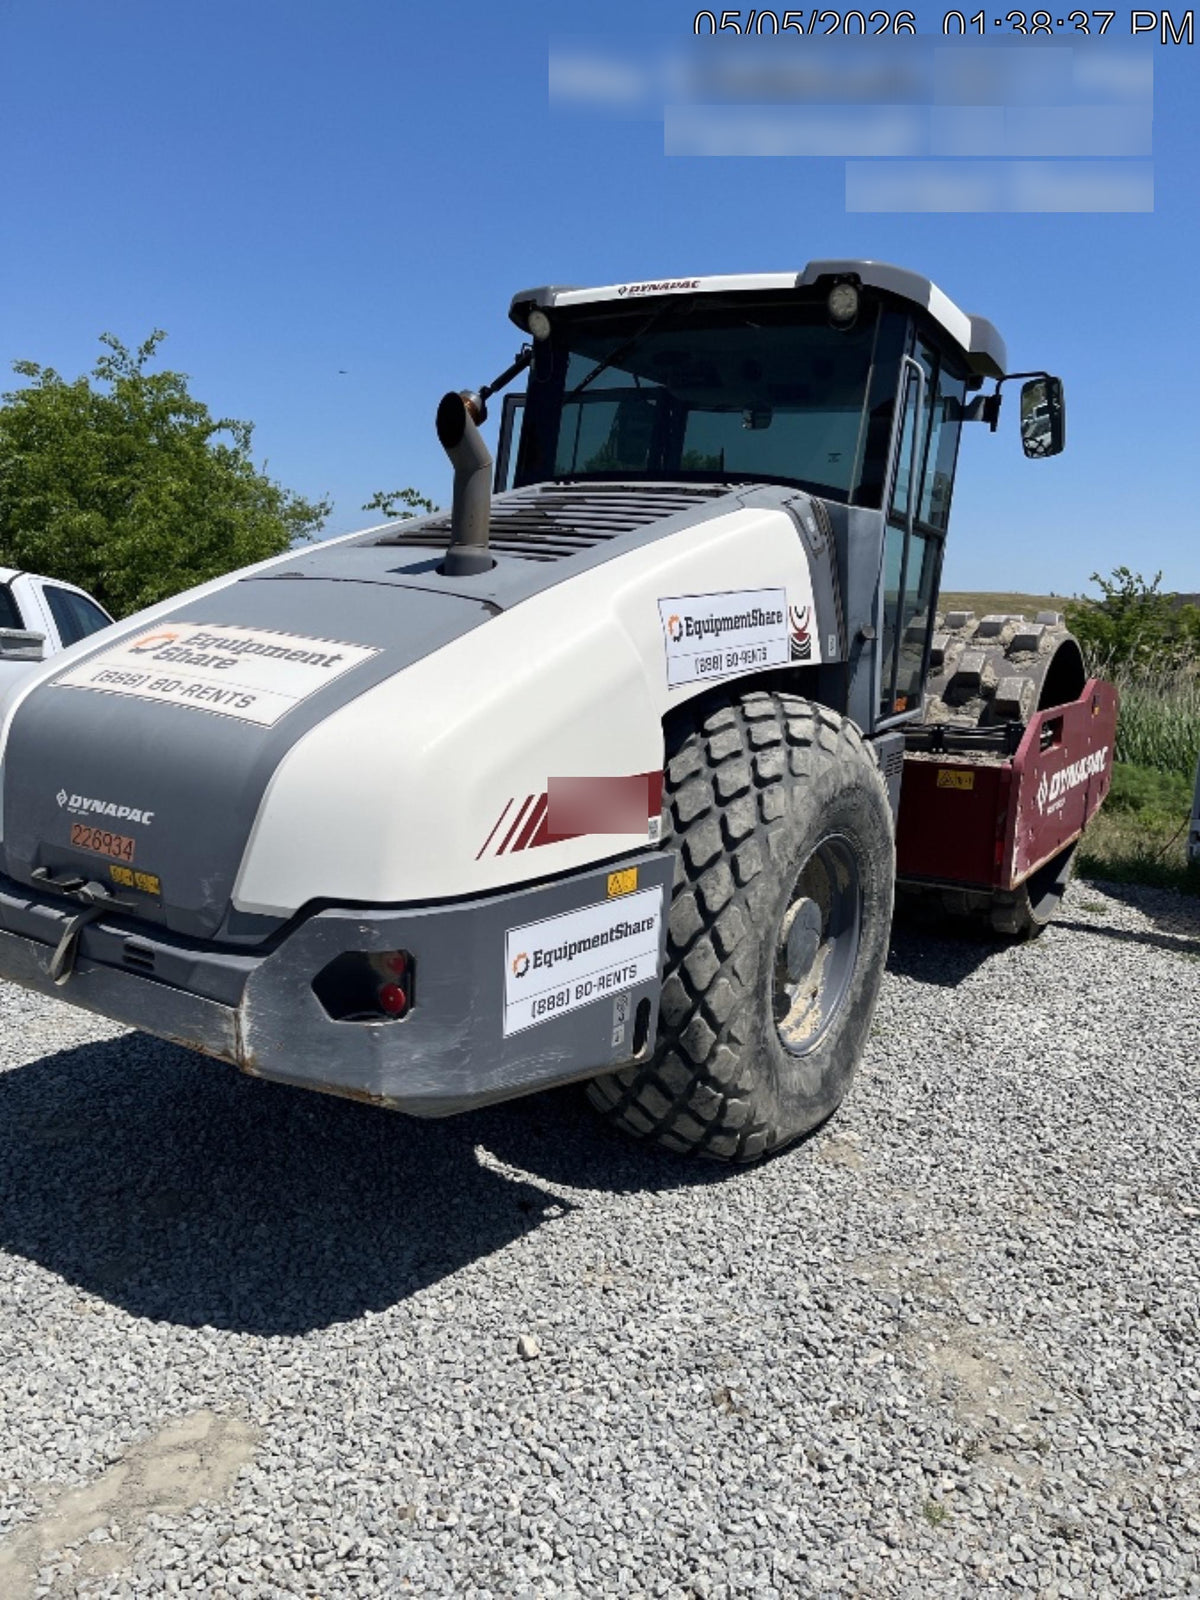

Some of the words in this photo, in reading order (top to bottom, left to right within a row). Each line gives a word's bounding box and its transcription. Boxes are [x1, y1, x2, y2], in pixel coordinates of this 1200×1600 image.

[629, 280, 701, 293] DYNAPAC
[684, 608, 783, 640] EquipmentShare
[152, 646, 238, 669] Share
[181, 632, 343, 668] Equipment
[149, 677, 257, 709] 80-RENTS
[1049, 746, 1109, 802] DYNAPAC
[68, 794, 155, 826] DYNAPAC
[72, 824, 134, 861] 226934
[532, 917, 655, 970] EquipmentShare
[575, 964, 637, 1001] 80-RENTS
